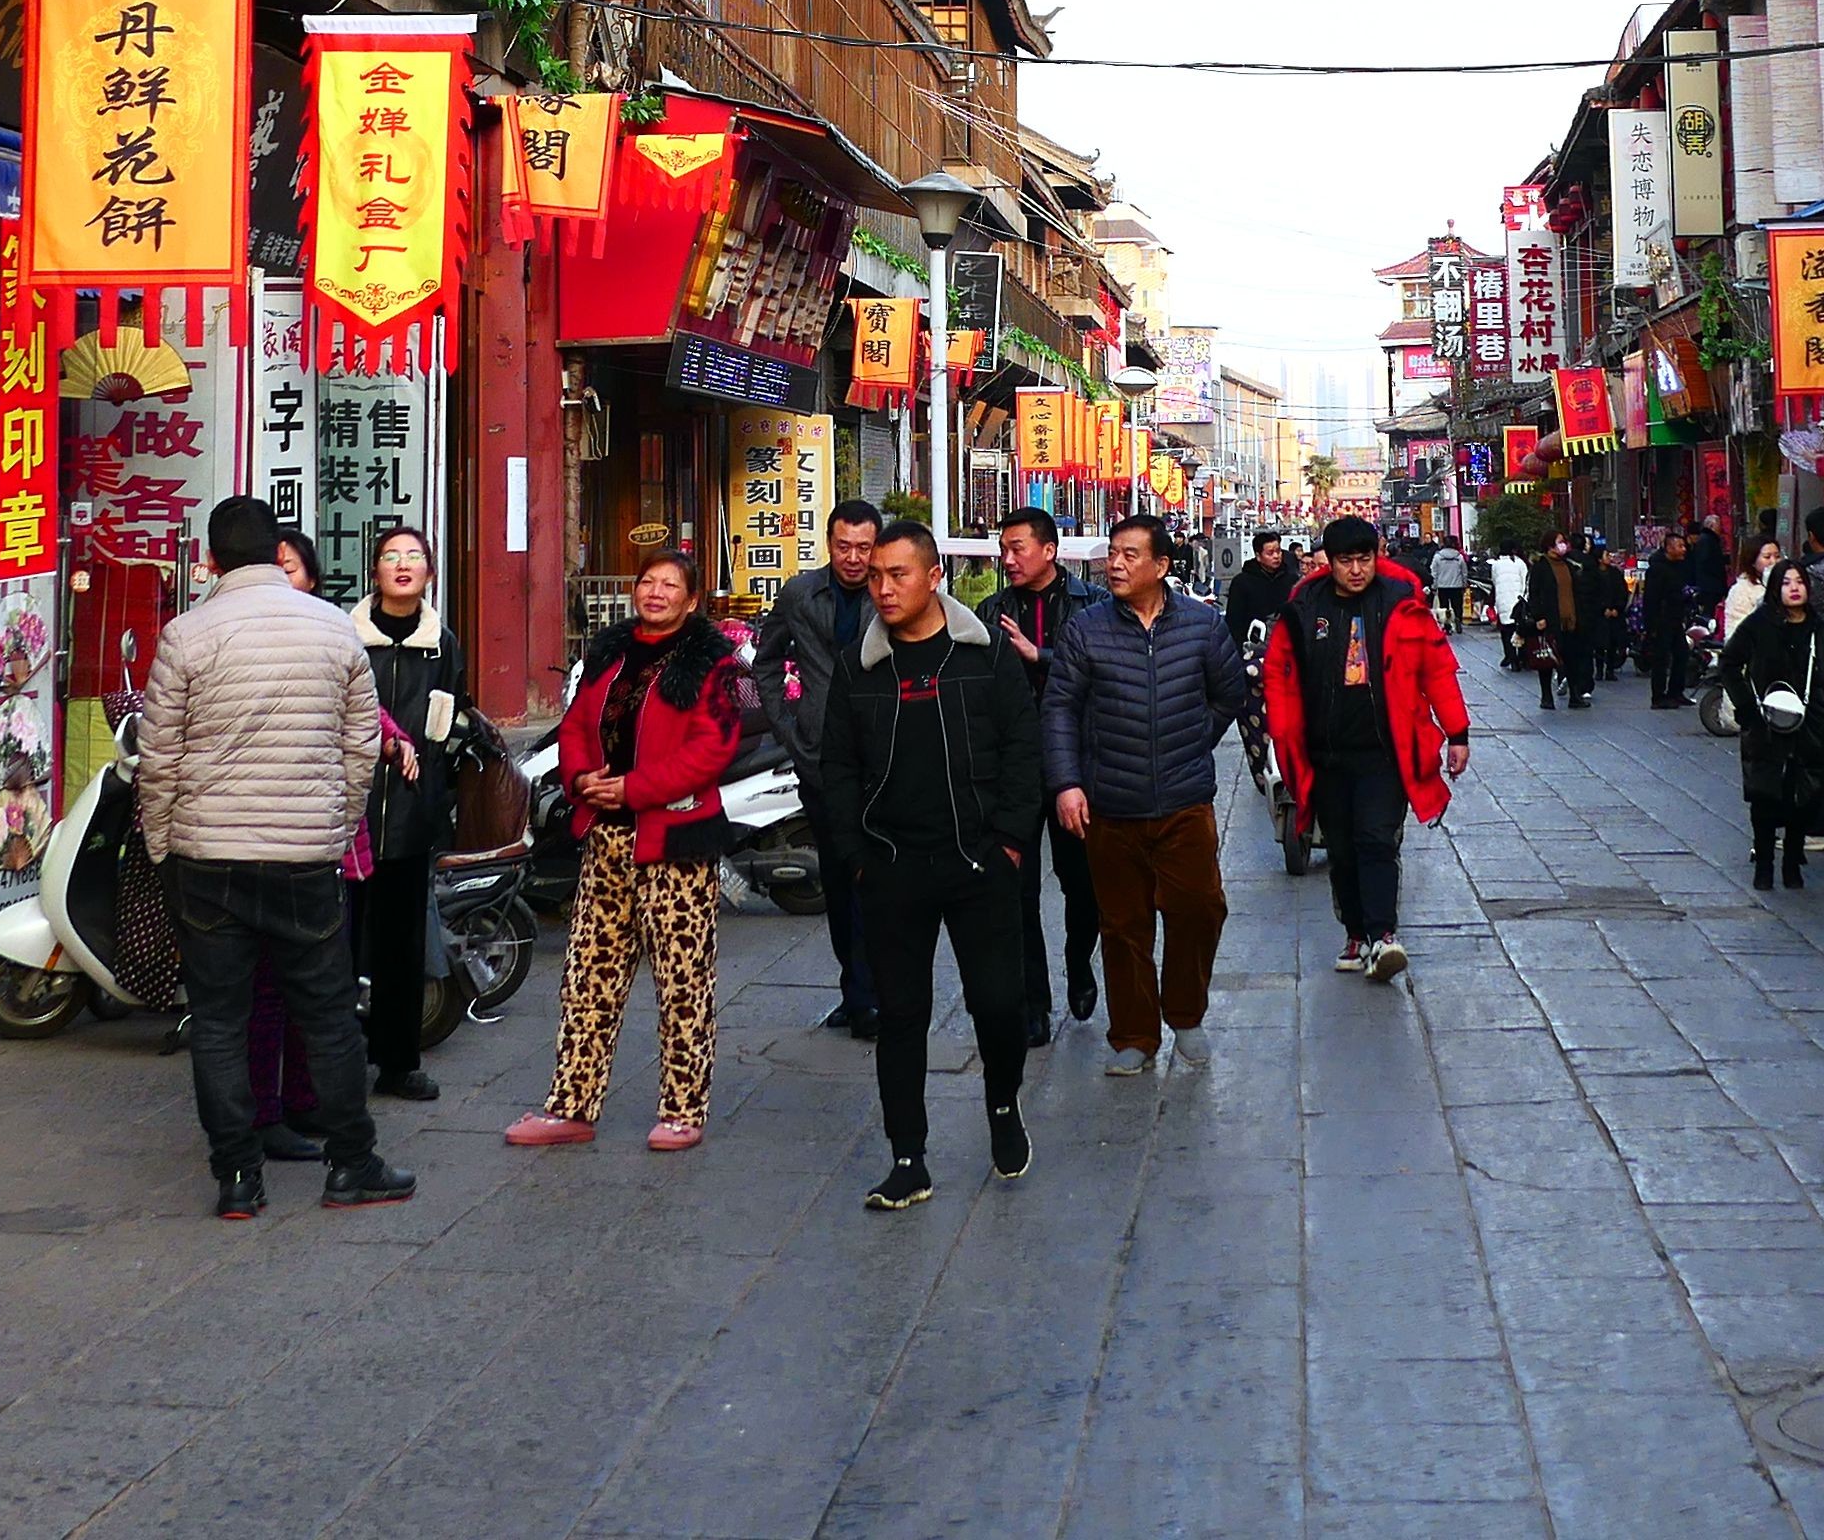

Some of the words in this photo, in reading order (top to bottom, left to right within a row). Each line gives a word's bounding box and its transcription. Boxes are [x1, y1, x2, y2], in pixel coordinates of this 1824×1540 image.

[354, 62, 414, 272] 金婵礼盒厂
[1432, 256, 1463, 357] 不翻汤
[1518, 244, 1556, 347] 杏花村
[269, 382, 304, 532] 字画
[745, 446, 783, 617] 篆刻书画印
